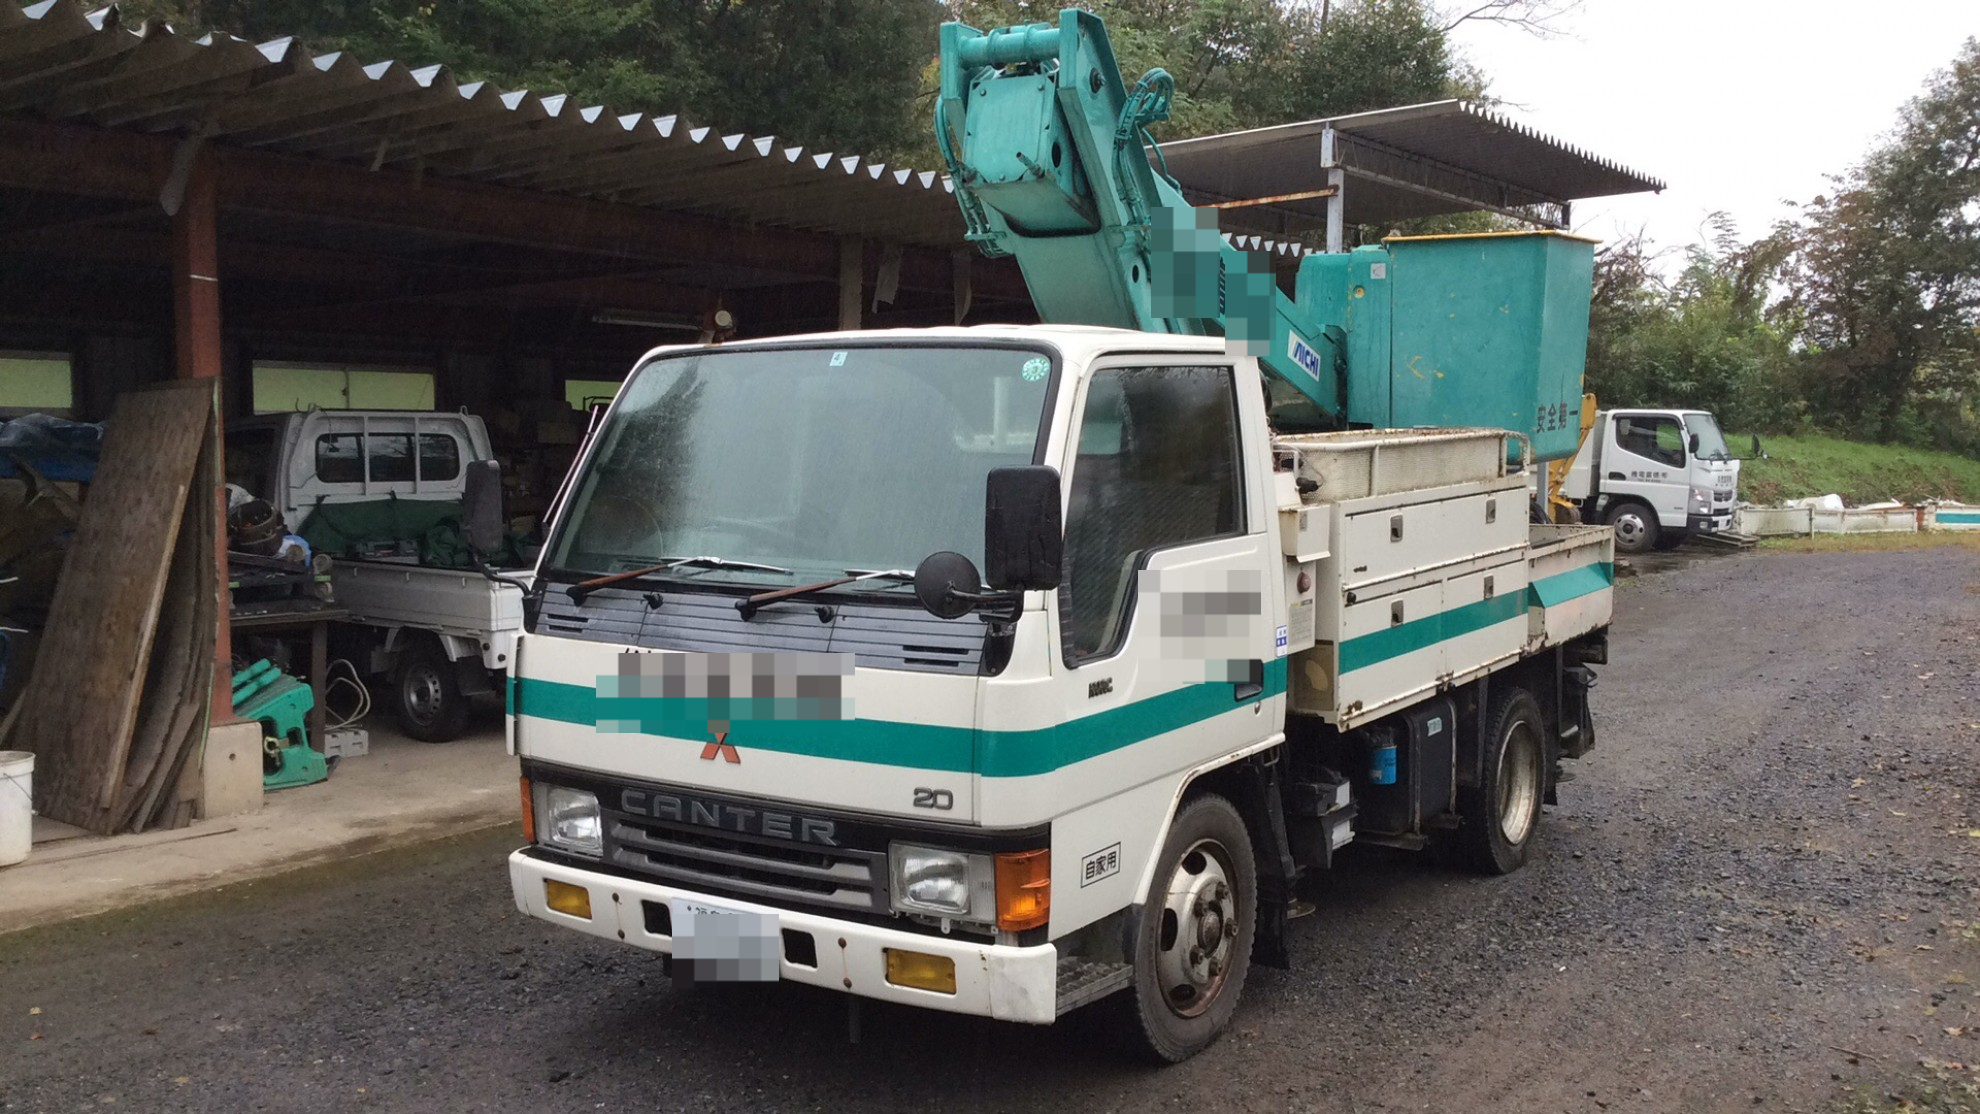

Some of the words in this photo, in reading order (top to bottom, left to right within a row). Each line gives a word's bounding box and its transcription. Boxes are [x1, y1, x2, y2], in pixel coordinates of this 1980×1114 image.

[1294, 341, 1319, 377] AICHI
[1536, 402, 1579, 434] 安全第一
[913, 787, 954, 810] 20
[621, 789, 841, 846] CANTER
[1085, 850, 1117, 880] 自家用
